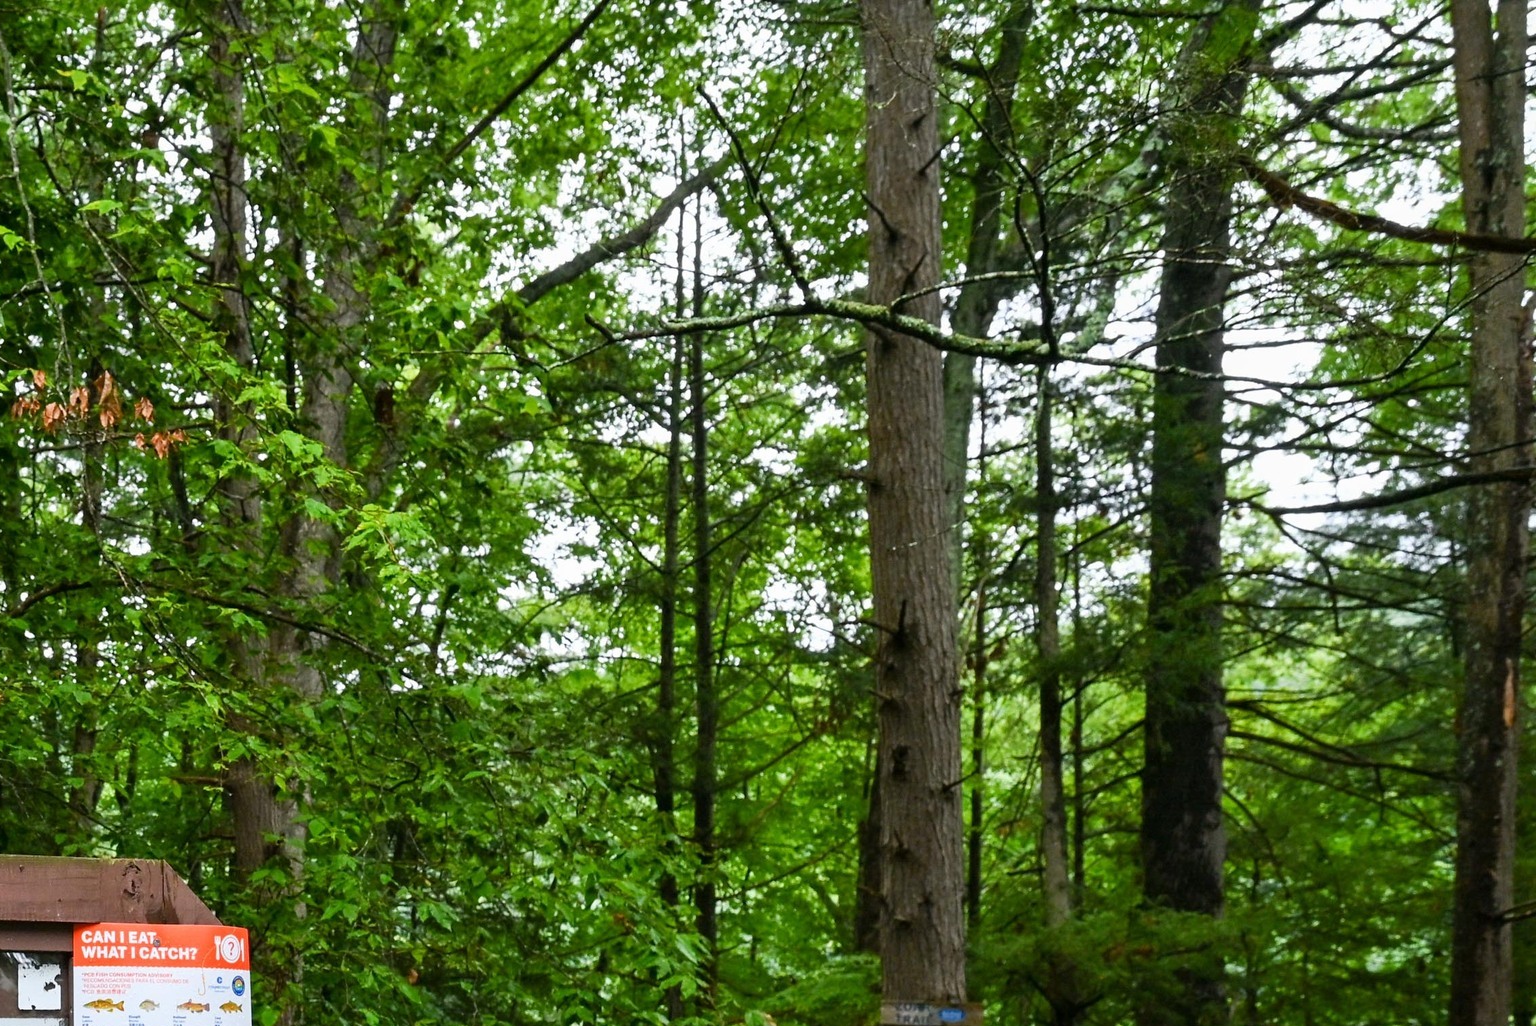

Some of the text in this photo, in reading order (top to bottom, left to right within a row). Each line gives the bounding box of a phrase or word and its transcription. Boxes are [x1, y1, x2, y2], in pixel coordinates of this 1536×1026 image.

[81, 931, 156, 944] CAN I EAT
[81, 946, 198, 960] WHAT I CATCH?
